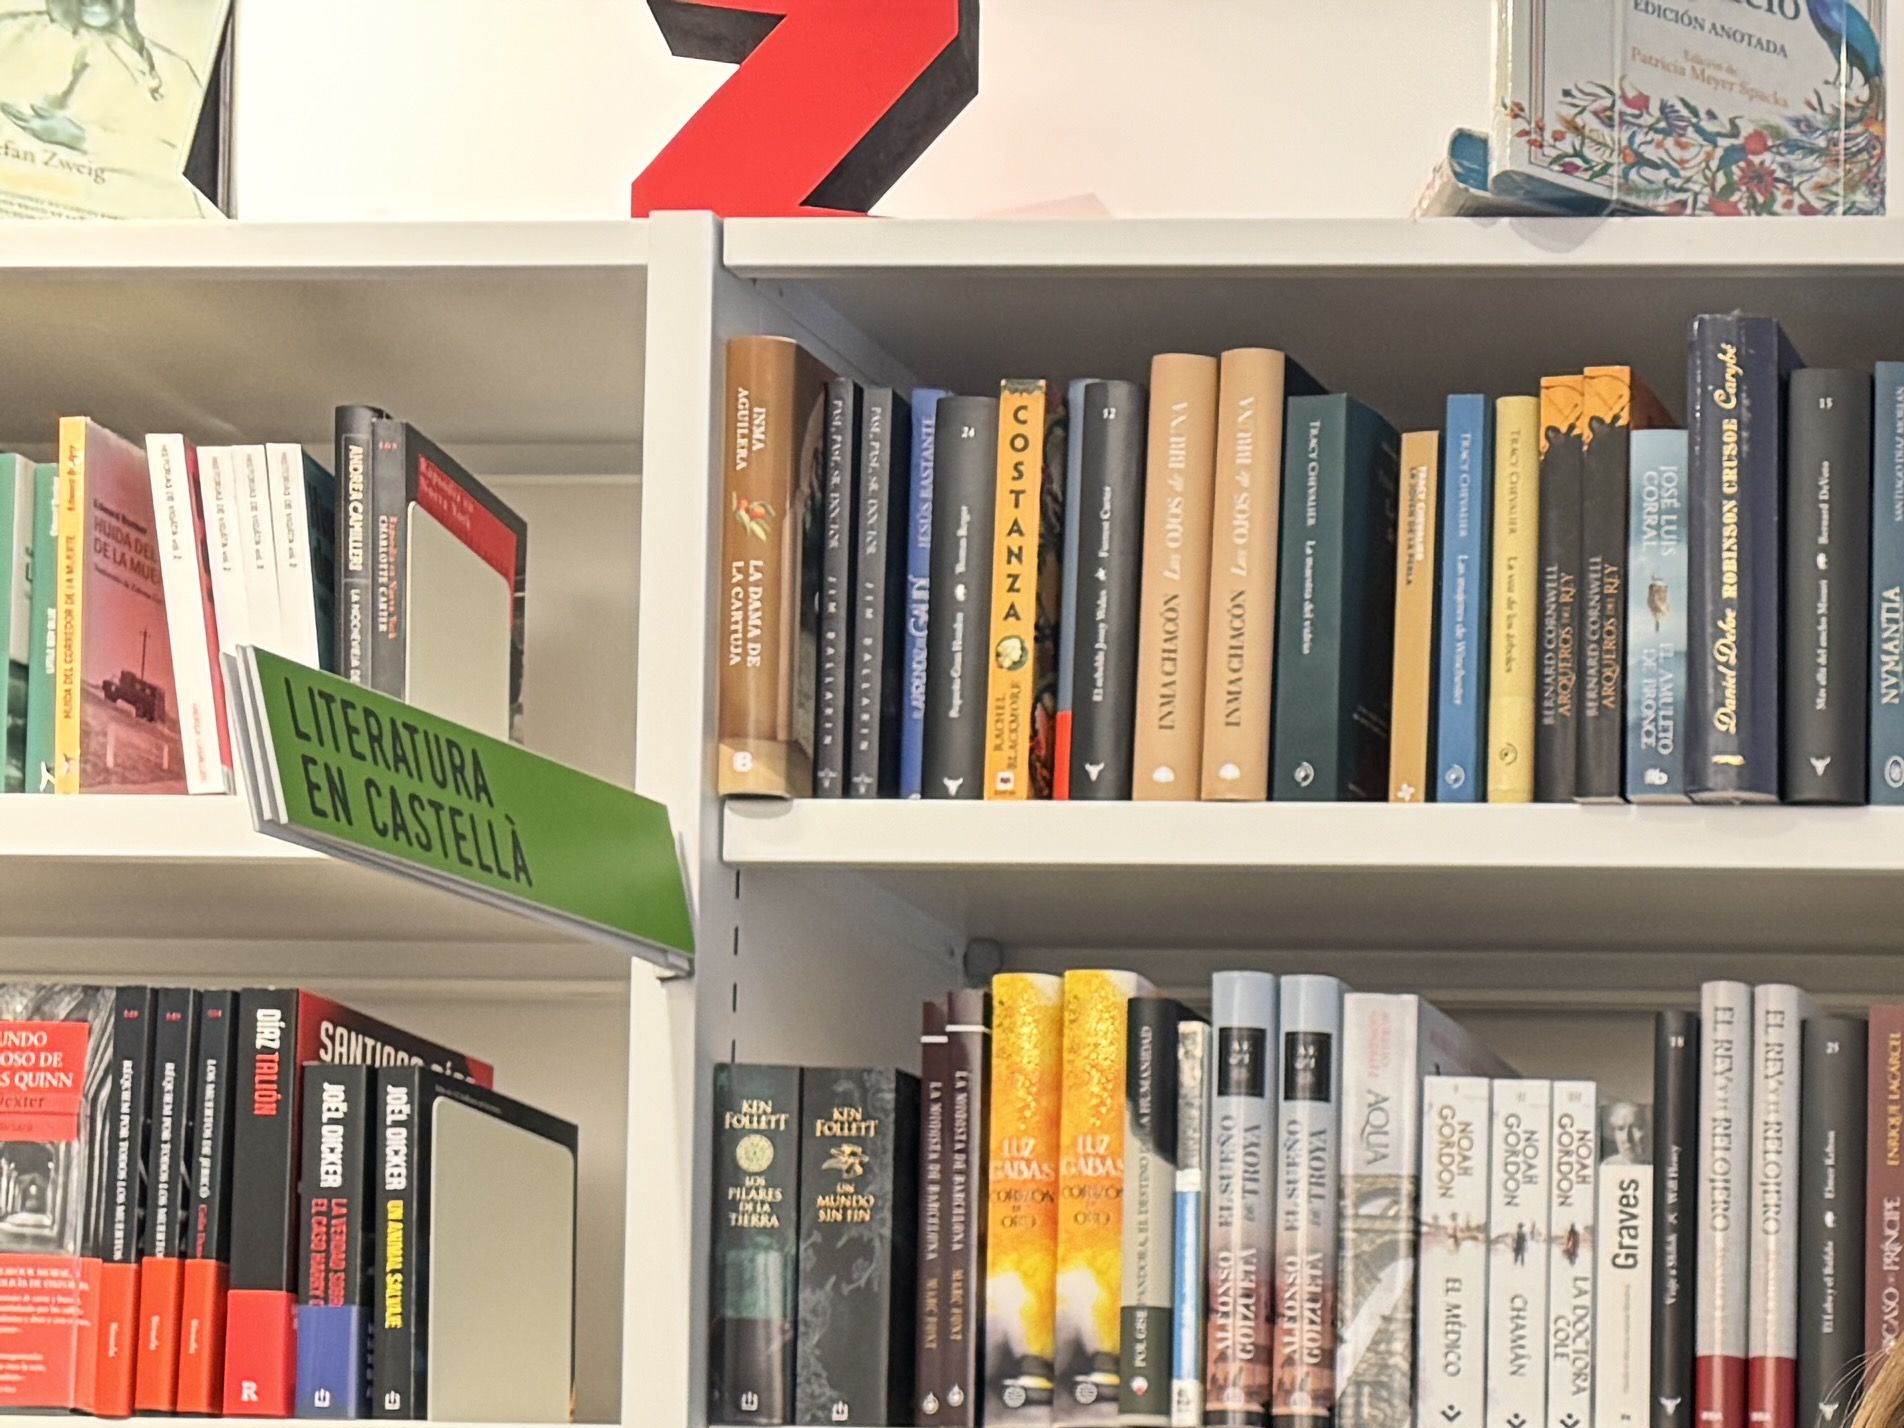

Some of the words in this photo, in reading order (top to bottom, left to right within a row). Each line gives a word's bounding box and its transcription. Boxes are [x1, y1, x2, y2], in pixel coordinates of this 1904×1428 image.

[1708, 22, 1788, 59] ANOTADA
[45, 150, 108, 185] Zweig
[735, 387, 750, 472] AGUILERA
[751, 405, 767, 452] INMA
[1723, 417, 1740, 512] CRUSOE
[1002, 403, 1031, 623] COSTANZA
[732, 559, 746, 580] LA
[749, 559, 765, 579] LA
[1722, 517, 1740, 600] ROBINSON
[728, 585, 745, 667] CARTUJA
[748, 583, 763, 637] DAMA
[746, 642, 761, 668] DE
[1714, 663, 1739, 735] Daniel
[284, 677, 494, 807] LITERATURA
[302, 755, 349, 818] EN
[368, 774, 534, 889] CASTELLÀ
[256, 1008, 282, 1050] DÍAZ
[254, 1052, 280, 1117] TALIÓN
[386, 1085, 409, 1125] JOËL
[741, 1099, 772, 1115] KEN
[723, 1112, 789, 1131] FOLLETT
[384, 1130, 408, 1192] DICKER
[1612, 1177, 1640, 1271] Graves
